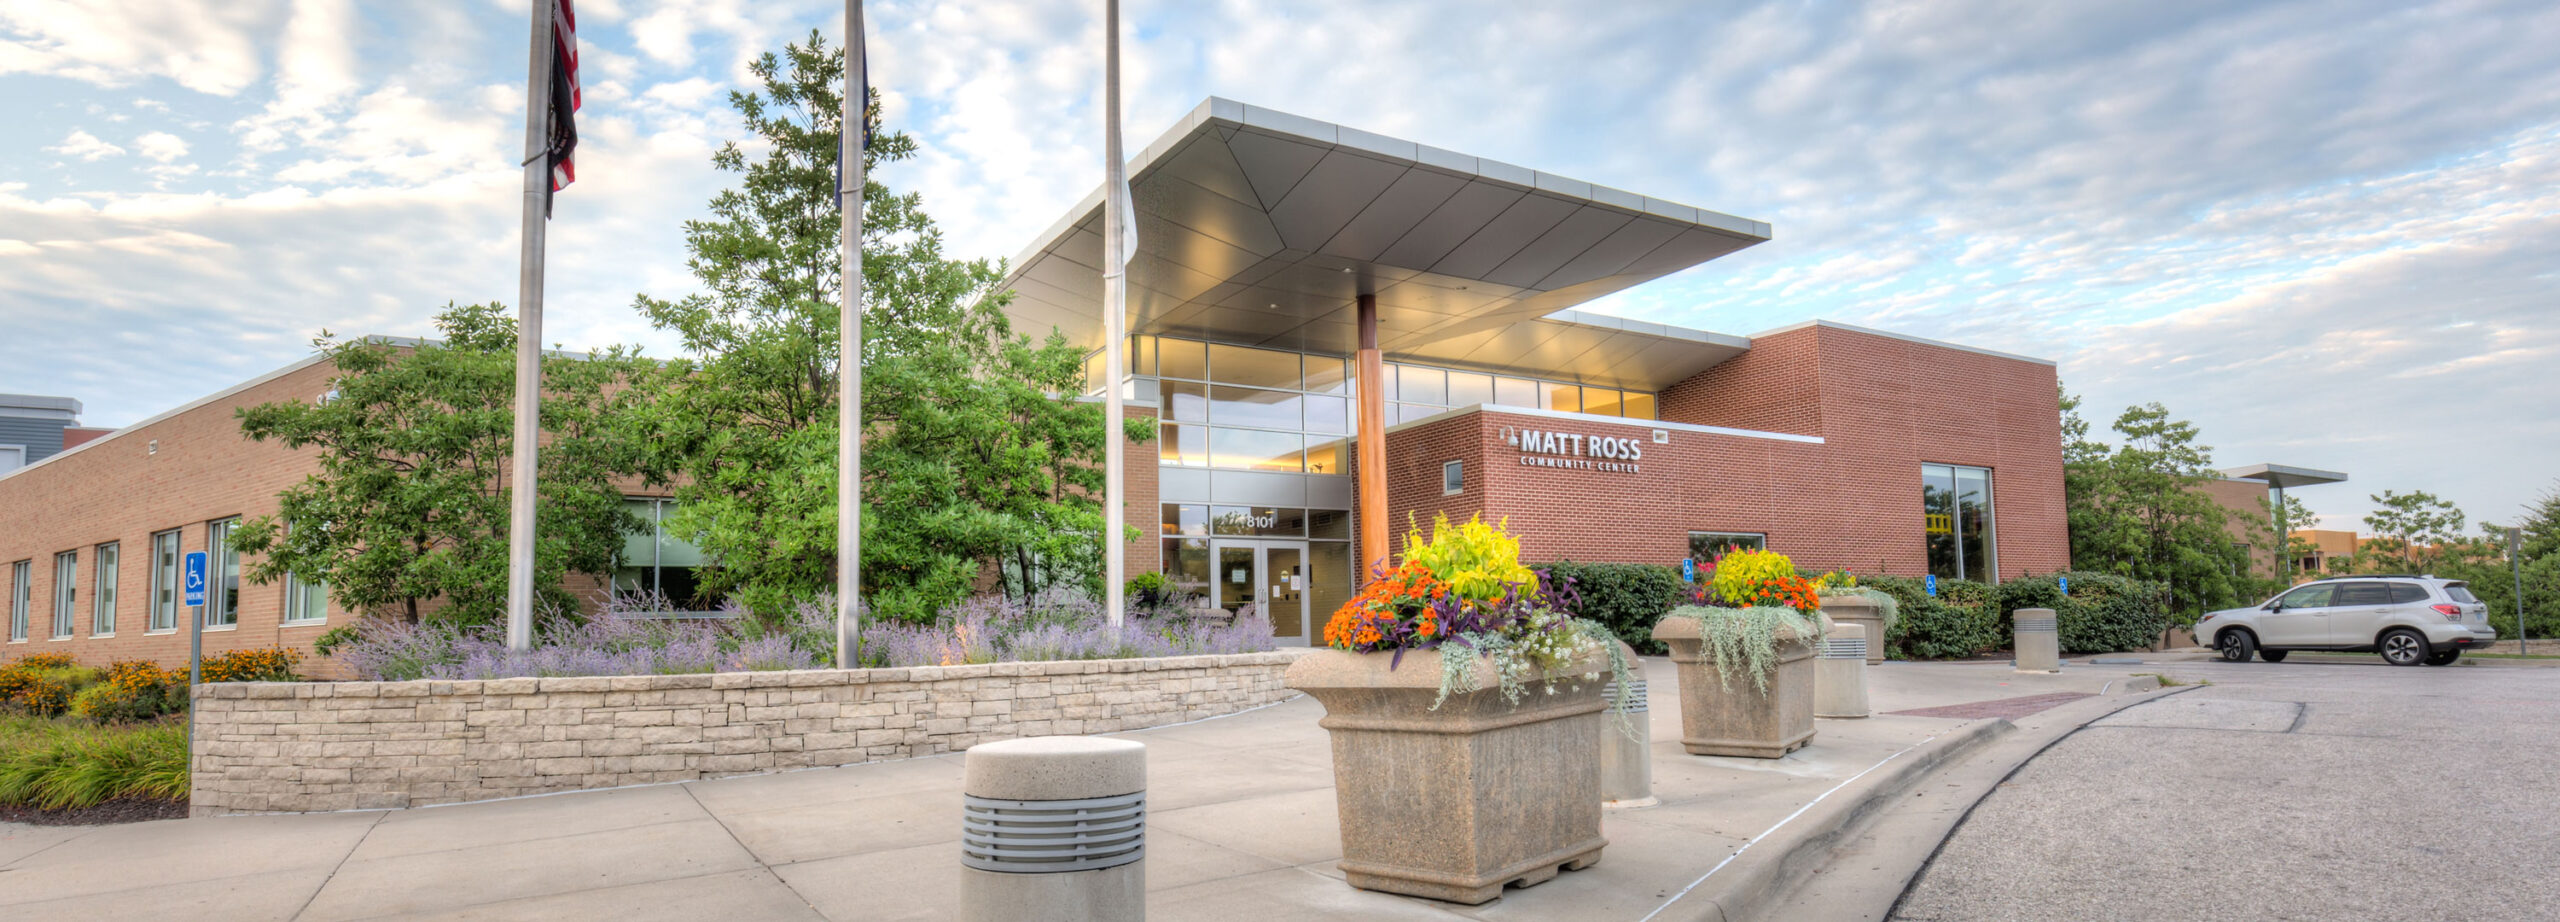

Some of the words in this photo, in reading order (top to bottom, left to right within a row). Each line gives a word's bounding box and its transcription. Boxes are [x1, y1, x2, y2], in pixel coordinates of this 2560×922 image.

[1521, 429, 1582, 456] MATT
[1588, 435, 1641, 460] ROSS
[1520, 456, 1591, 469] COMMUNITY
[1597, 462, 1639, 473] CENTER
[1247, 516, 1273, 528] 8101
